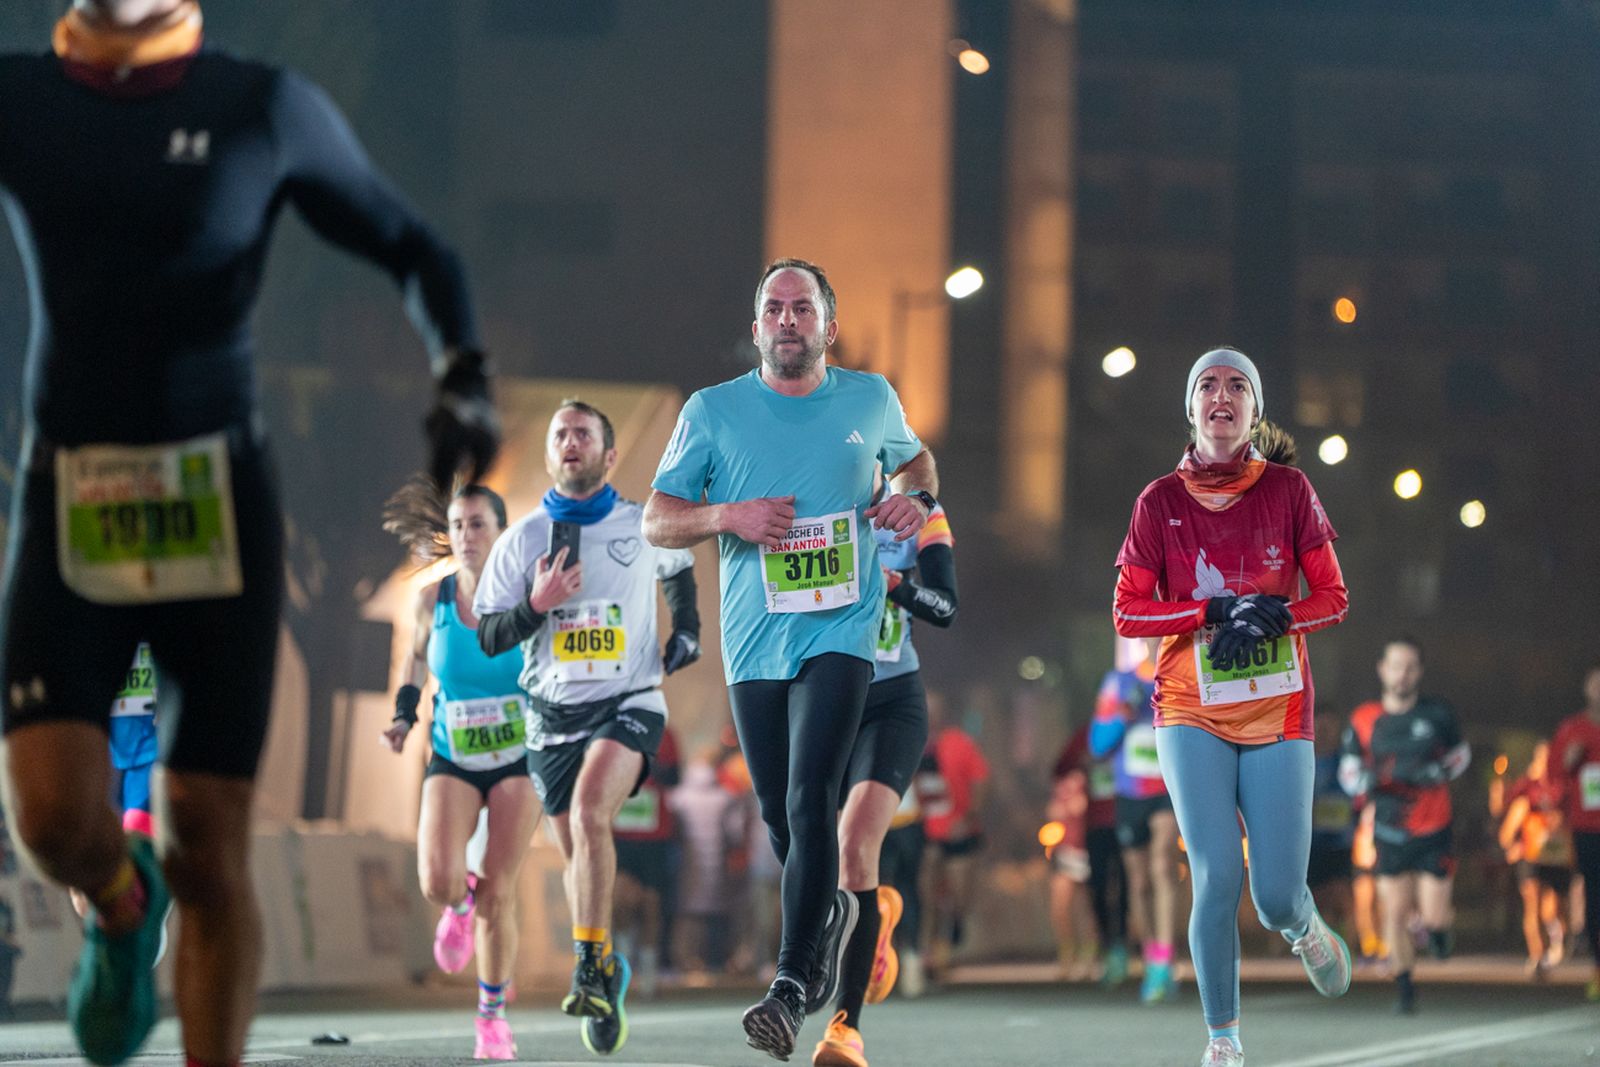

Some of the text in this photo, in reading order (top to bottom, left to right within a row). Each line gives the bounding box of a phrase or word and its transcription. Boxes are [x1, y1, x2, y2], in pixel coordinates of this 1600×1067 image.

[783, 528, 811, 540] OCHE
[813, 527, 825, 537] DE
[771, 543, 790, 553] SAN
[793, 537, 826, 550] ANTÓN
[784, 547, 839, 581] 3716
[564, 629, 614, 653] 4069
